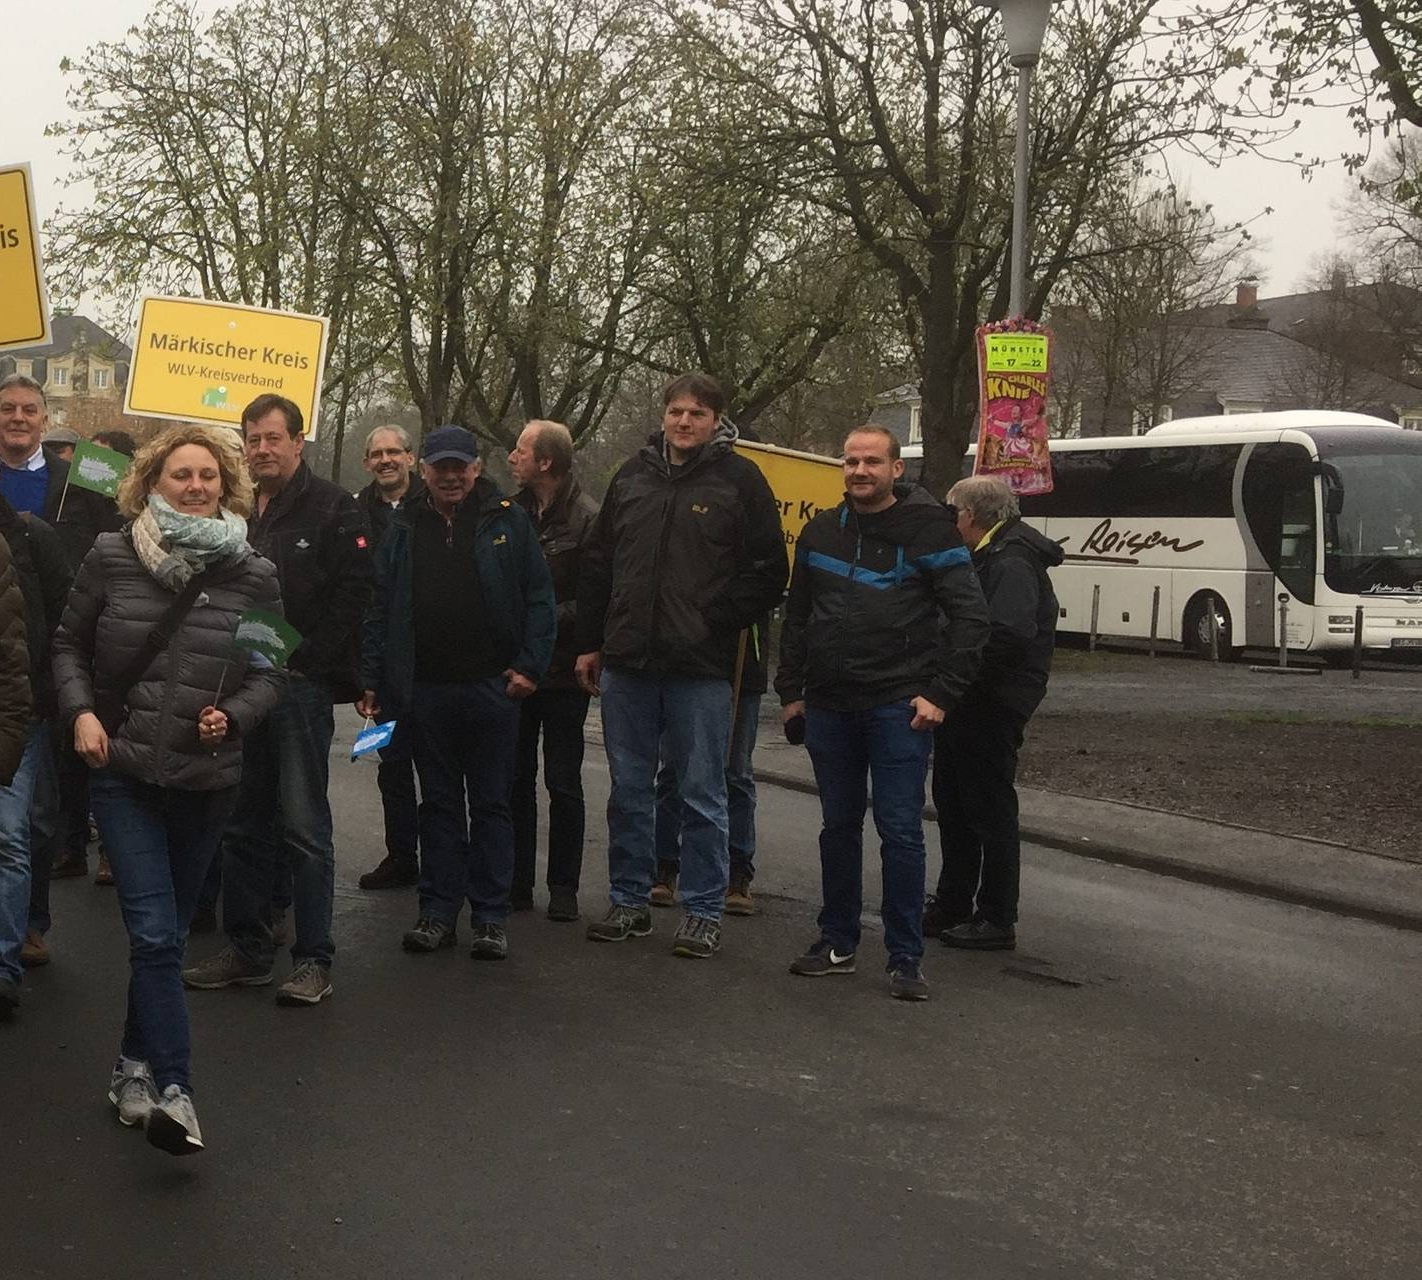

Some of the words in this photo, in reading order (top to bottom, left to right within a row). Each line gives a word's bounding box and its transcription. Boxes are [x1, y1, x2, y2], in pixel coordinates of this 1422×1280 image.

[149, 332, 257, 362] Märkischer
[262, 346, 309, 370] Kreis
[1006, 358, 1017, 367] 17
[167, 362, 284, 389] WLV-Kreisverband
[987, 377, 1031, 400] KNIE
[1080, 518, 1204, 555] Reisen
